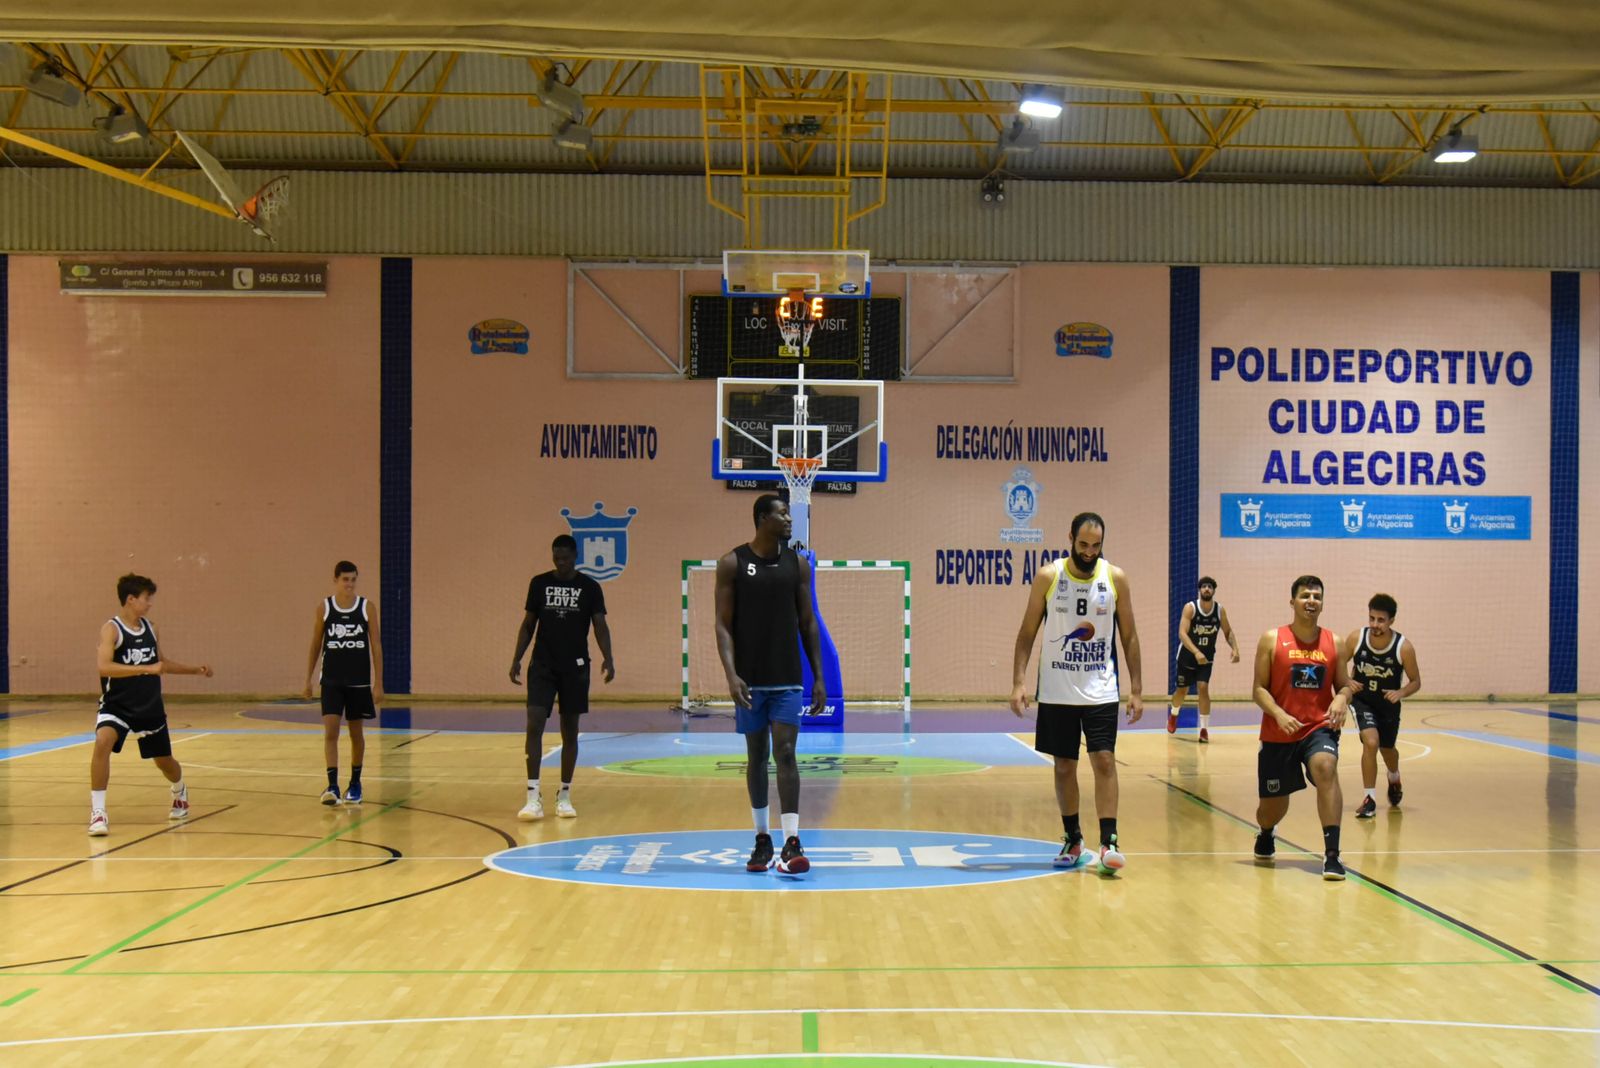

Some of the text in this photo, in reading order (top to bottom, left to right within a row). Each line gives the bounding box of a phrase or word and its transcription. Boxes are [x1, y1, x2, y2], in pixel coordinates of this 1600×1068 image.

[100, 267, 110, 276] C/
[112, 267, 145, 276] General
[147, 267, 173, 277] Primo
[175, 268, 185, 277] de
[188, 268, 218, 278] Rivera,
[259, 273, 322, 283] 956 632 118
[818, 318, 848, 331] VISIT.
[1210, 346, 1533, 387] POLIDEPORTIVO
[1267, 398, 1486, 435] CIUDAD DE
[540, 423, 658, 460] AYUNTAMIENTO
[936, 419, 1108, 463] DELEGACIÓN MUNICIPAL
[1262, 449, 1487, 487] ALGECIRAS
[732, 480, 757, 489] FALTAS
[827, 482, 852, 492] FALTAS
[1264, 511, 1312, 521] Ayuntamiento
[1366, 512, 1414, 522] Ayuntamiento
[1469, 514, 1516, 523] Ayuntamiento
[1273, 520, 1312, 529] Algeciras
[1376, 520, 1414, 530] Algeciras
[1478, 521, 1516, 531] Algeciras
[746, 563, 757, 576] 5
[936, 548, 1013, 586] DEPORTES
[545, 586, 582, 598] CREW
[545, 595, 579, 608] LOVE
[1076, 598, 1088, 616] 8
[326, 640, 366, 649] EVOS
[1071, 641, 1106, 652] ENER
[1198, 636, 1209, 646] 10
[1064, 651, 1106, 662] DRINK
[1288, 649, 1328, 662] ESPAÑA
[1051, 660, 1107, 672] ENERGY DRINK
[1368, 680, 1378, 692] 9
